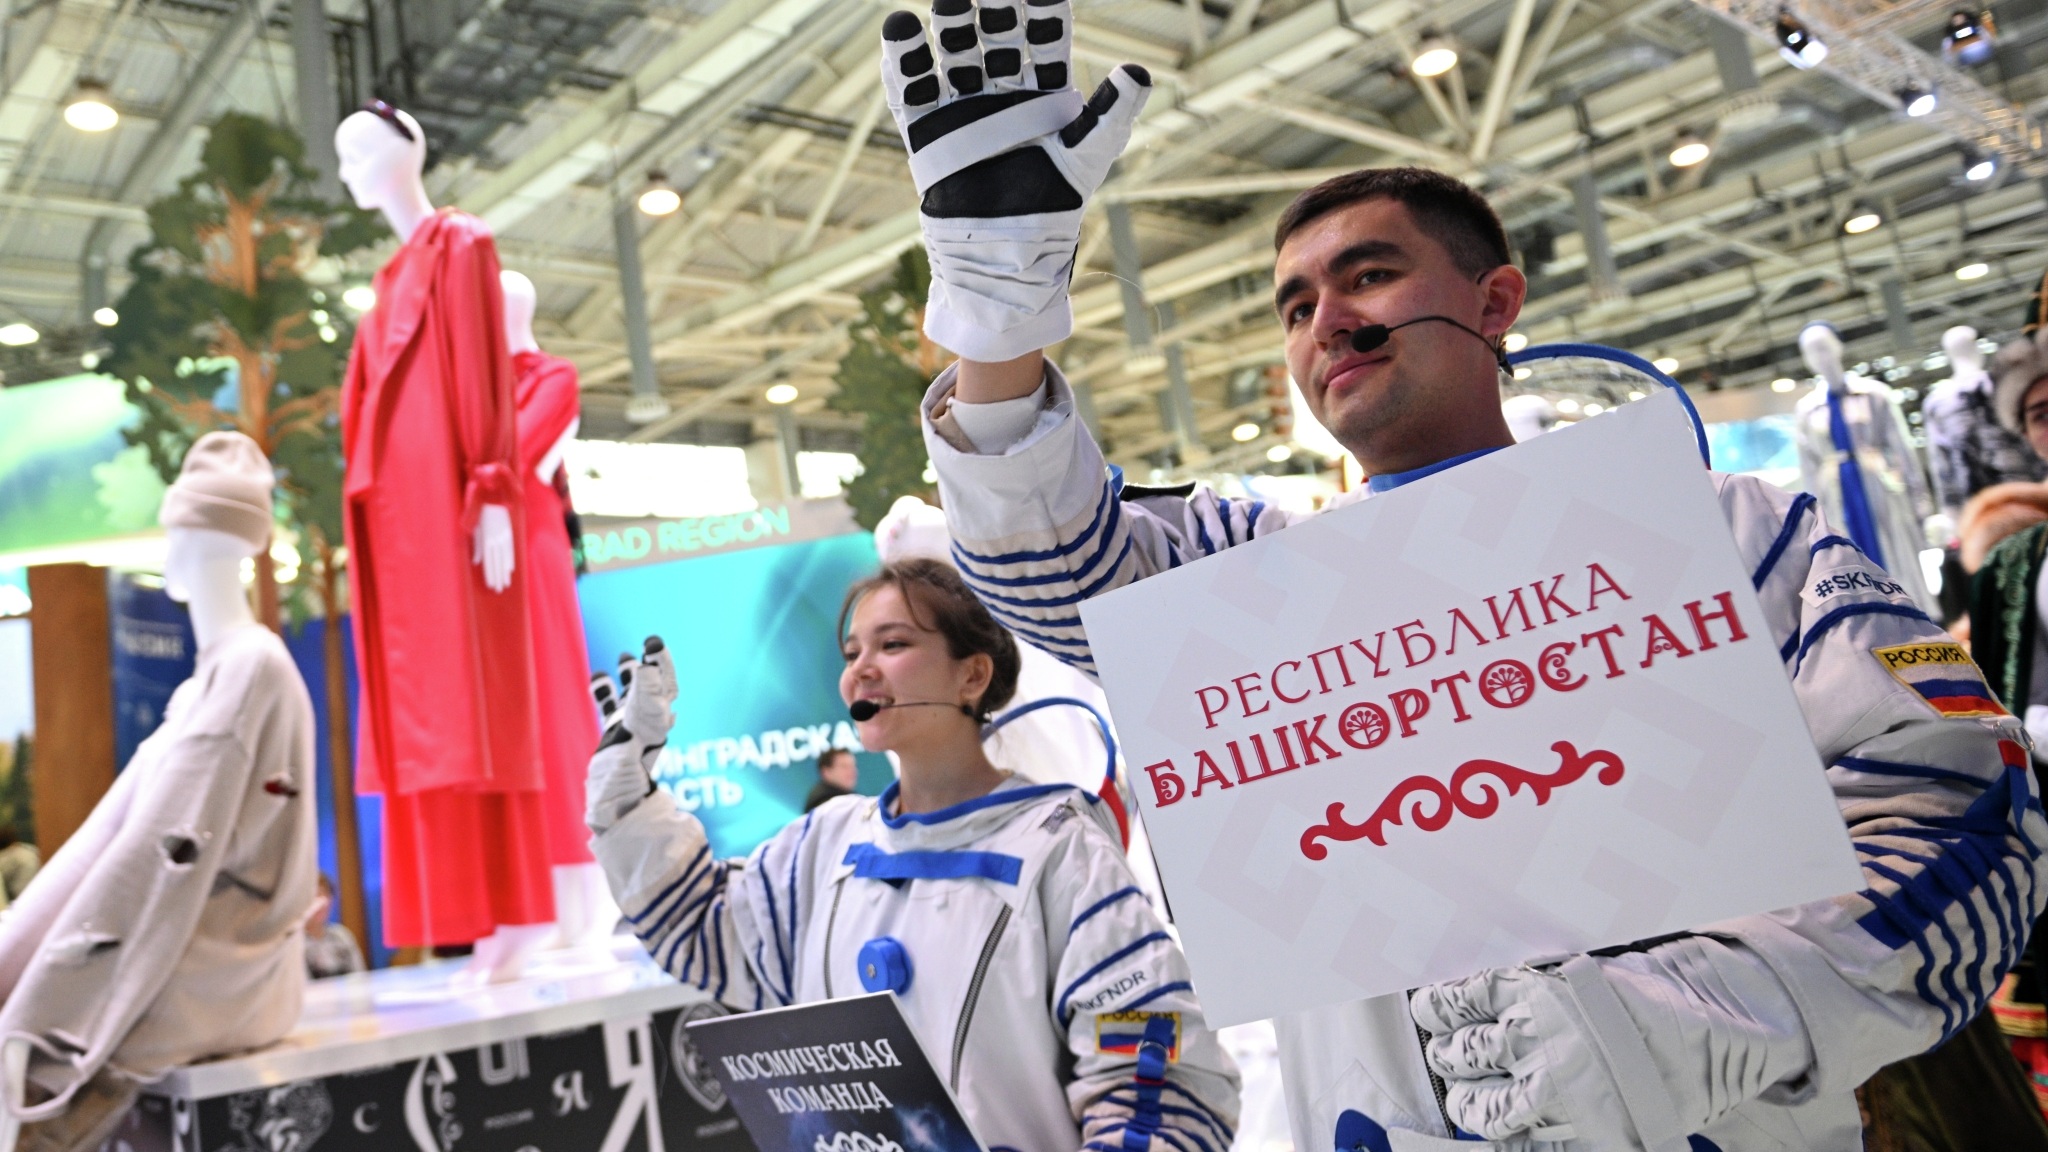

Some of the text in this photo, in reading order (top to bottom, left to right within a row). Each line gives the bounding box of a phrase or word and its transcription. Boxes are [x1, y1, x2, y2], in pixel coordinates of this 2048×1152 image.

[576, 505, 790, 564] RAD REGION
[1195, 562, 1631, 729] РЕСПУБЛИКА
[1884, 647, 1965, 668] РОССИЯ
[1144, 591, 1749, 808] БАШКОРТОСТАН
[650, 720, 864, 779] ИНГРАДСКА
[721, 1038, 902, 1082] КОСМИЧЕСКАЯ
[767, 1081, 894, 1114] КОМАНДА
